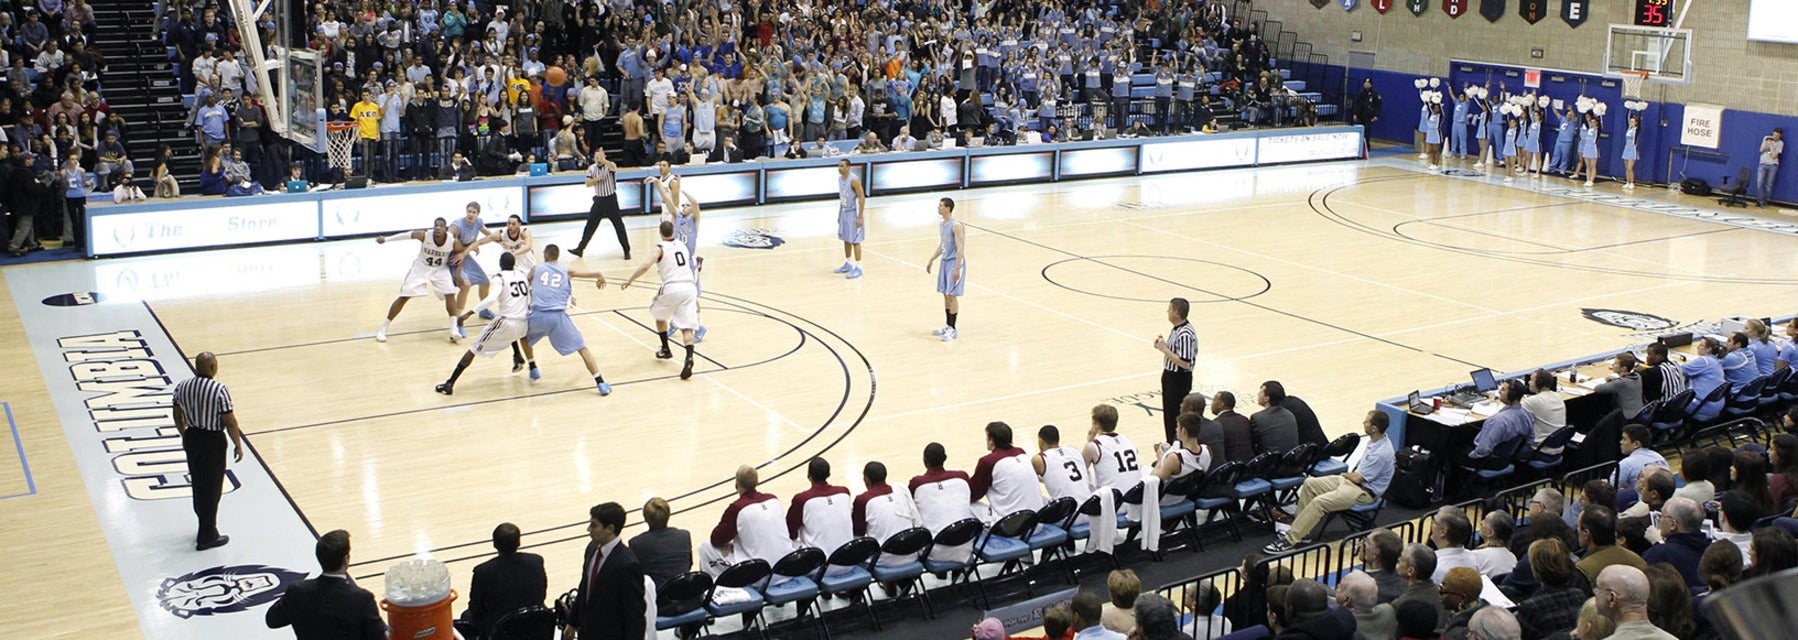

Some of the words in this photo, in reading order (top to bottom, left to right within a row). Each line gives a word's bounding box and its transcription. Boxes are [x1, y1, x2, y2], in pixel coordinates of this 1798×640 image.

[1569, 2, 1580, 20] E
[1643, 4, 1663, 24] 35
[1687, 127, 1712, 137] HOSE
[1690, 118, 1711, 128] FIRE
[146, 222, 183, 238] The
[227, 216, 278, 232] Store
[425, 257, 443, 267] 44
[675, 252, 686, 267] 0
[510, 281, 528, 297] 30
[540, 271, 562, 289] 42
[1113, 449, 1139, 473] 12
[1063, 460, 1082, 482] 3
